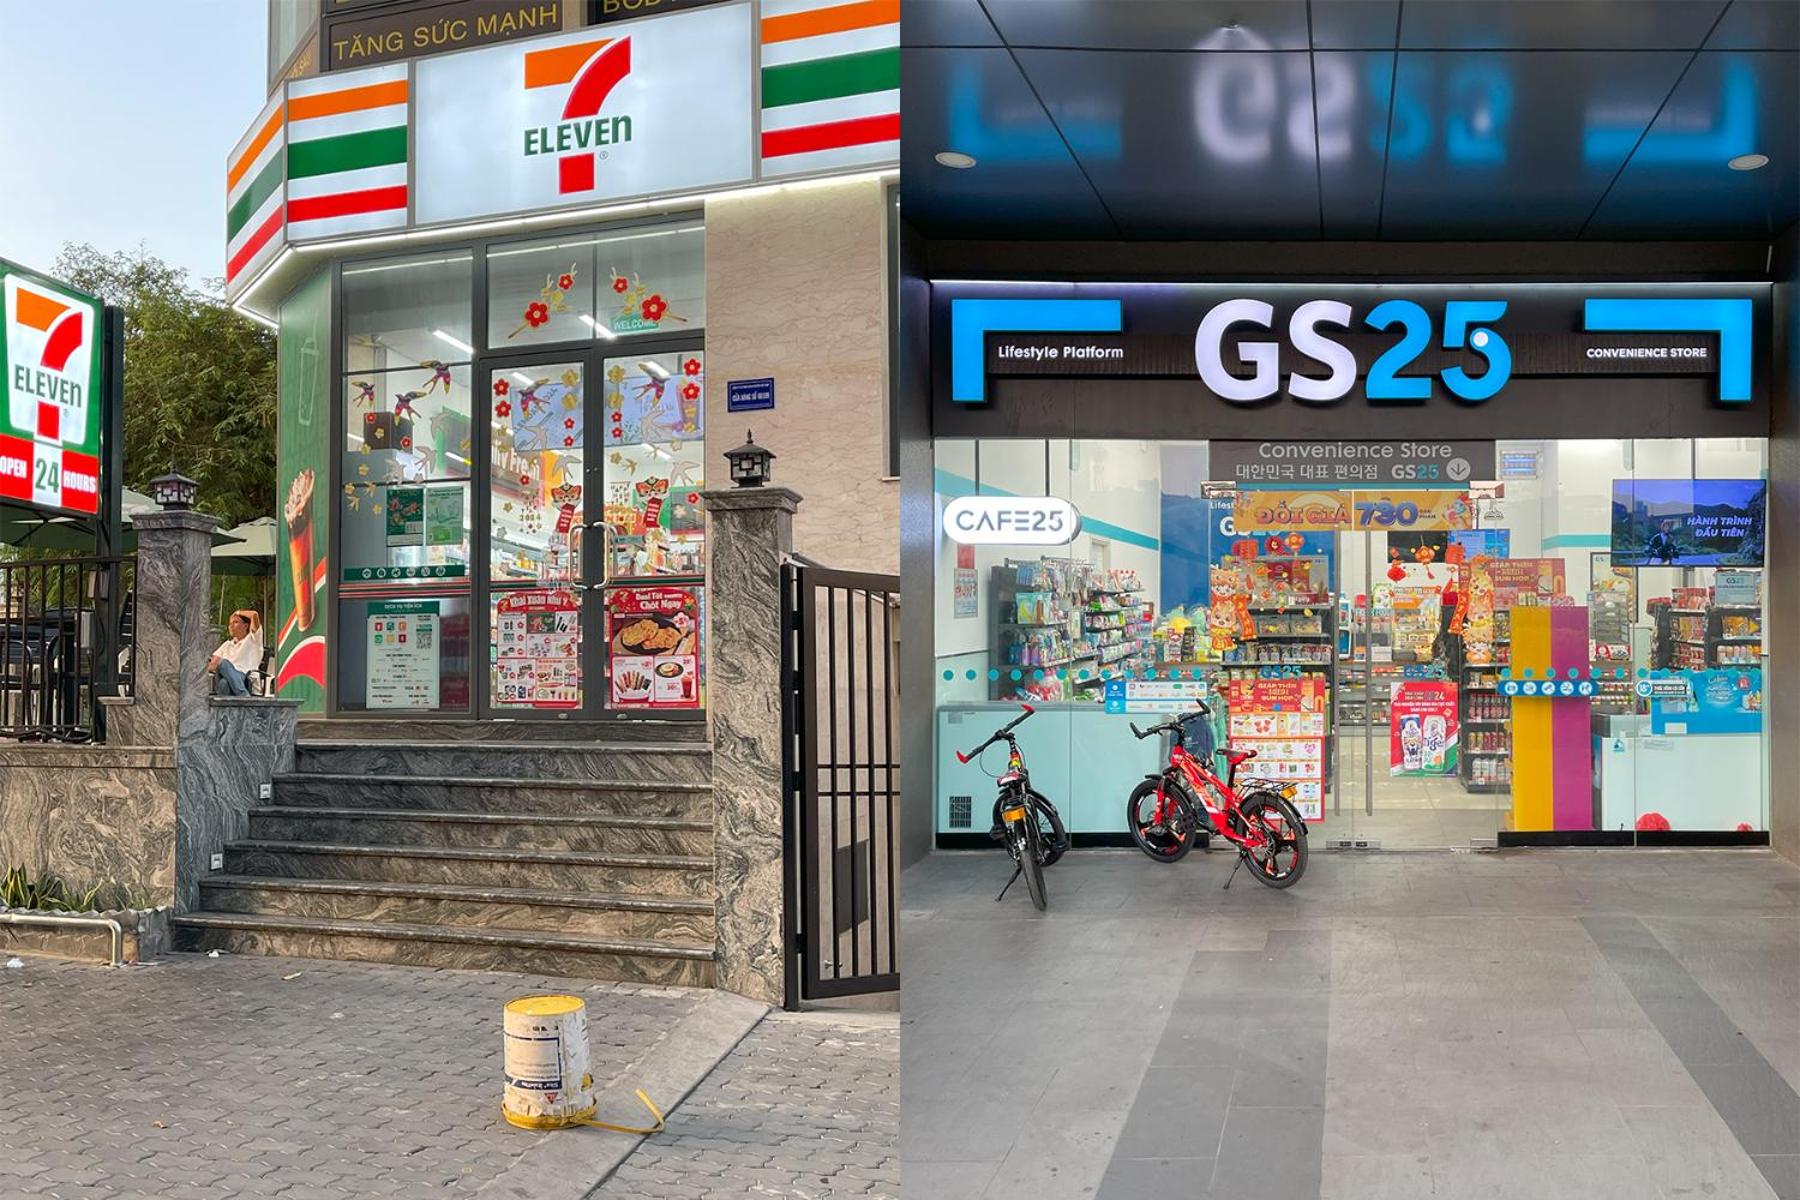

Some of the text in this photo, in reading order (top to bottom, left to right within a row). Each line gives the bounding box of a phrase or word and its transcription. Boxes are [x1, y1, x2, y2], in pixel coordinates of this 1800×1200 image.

[333, 4, 558, 60] TĂNG SỨC MẠNH
[998, 345, 1124, 361] Lifestyle Platform
[1195, 299, 1512, 402] GS25
[1586, 347, 1708, 358] CONVENIENCE STORE
[1259, 442, 1452, 458] Convenience Store
[0, 456, 96, 494] OPEN 24 HOURS
[1236, 463, 1440, 480] 대한민국 대표 편의점 GS25
[956, 510, 1064, 532] CAFE25
